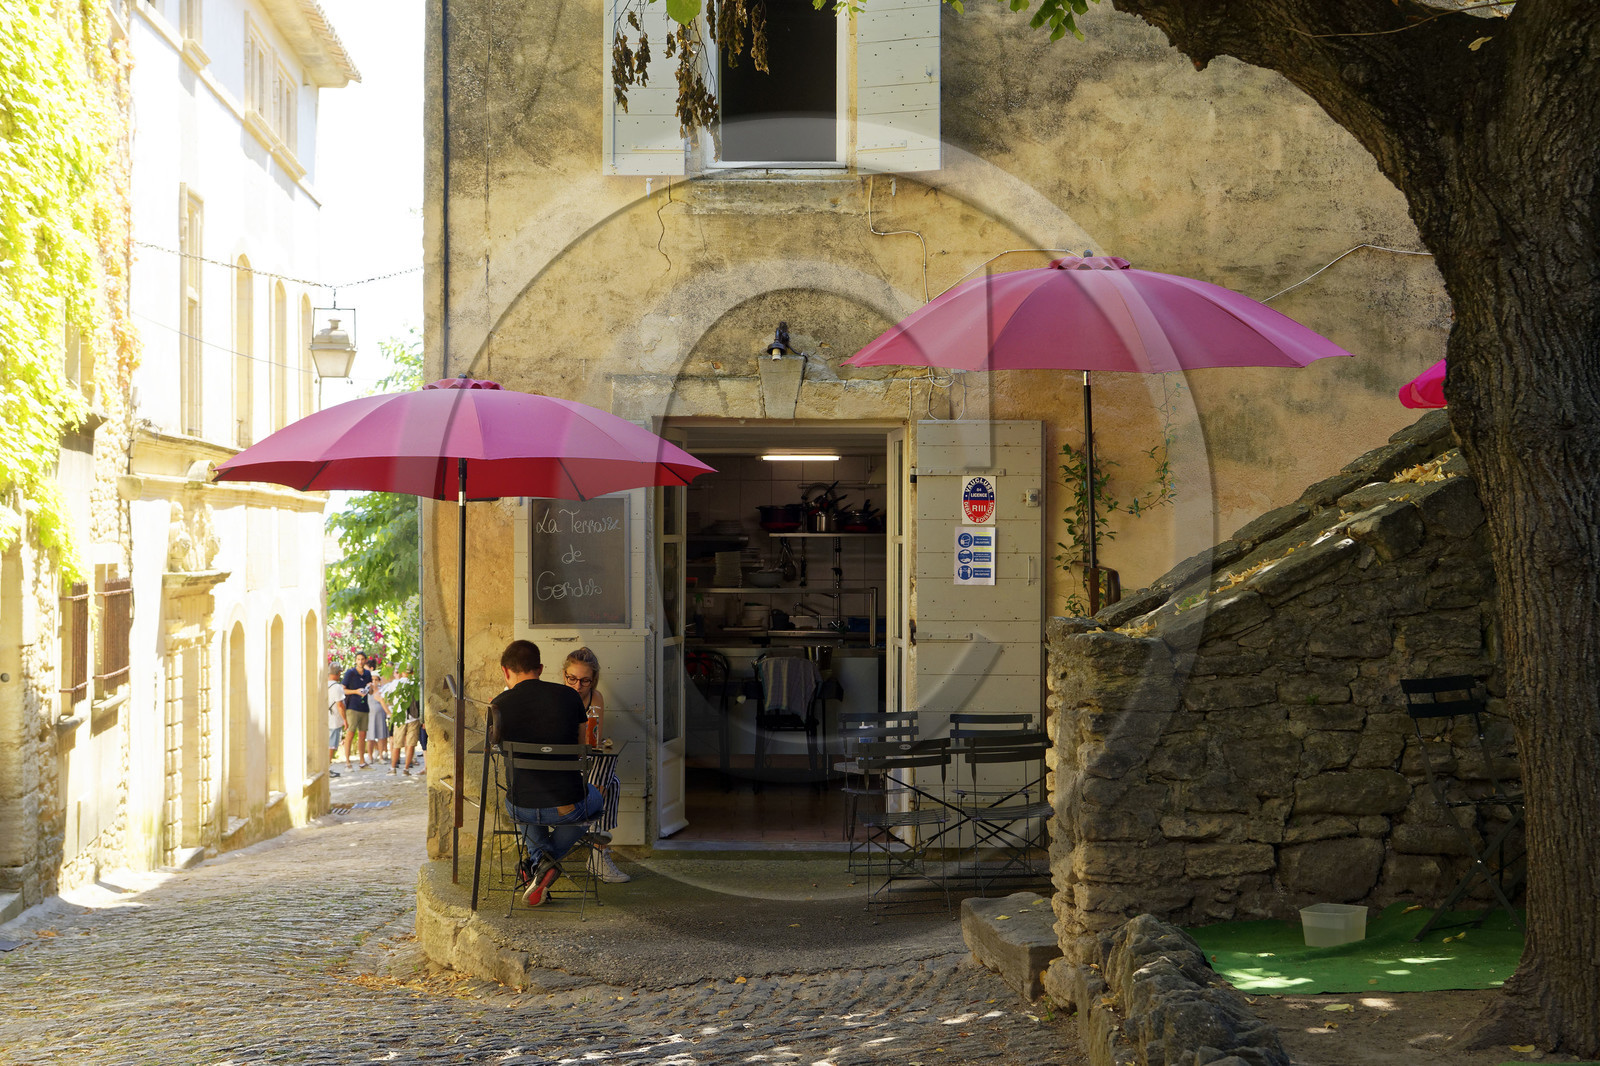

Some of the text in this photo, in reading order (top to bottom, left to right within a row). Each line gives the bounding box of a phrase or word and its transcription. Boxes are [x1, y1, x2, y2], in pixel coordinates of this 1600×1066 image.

[965, 478, 994, 493] VAUCLUSE
[972, 504, 986, 512] RIII
[975, 501, 994, 523] BOISSONS
[536, 509, 621, 533] La Terrasse
[561, 544, 586, 564] de
